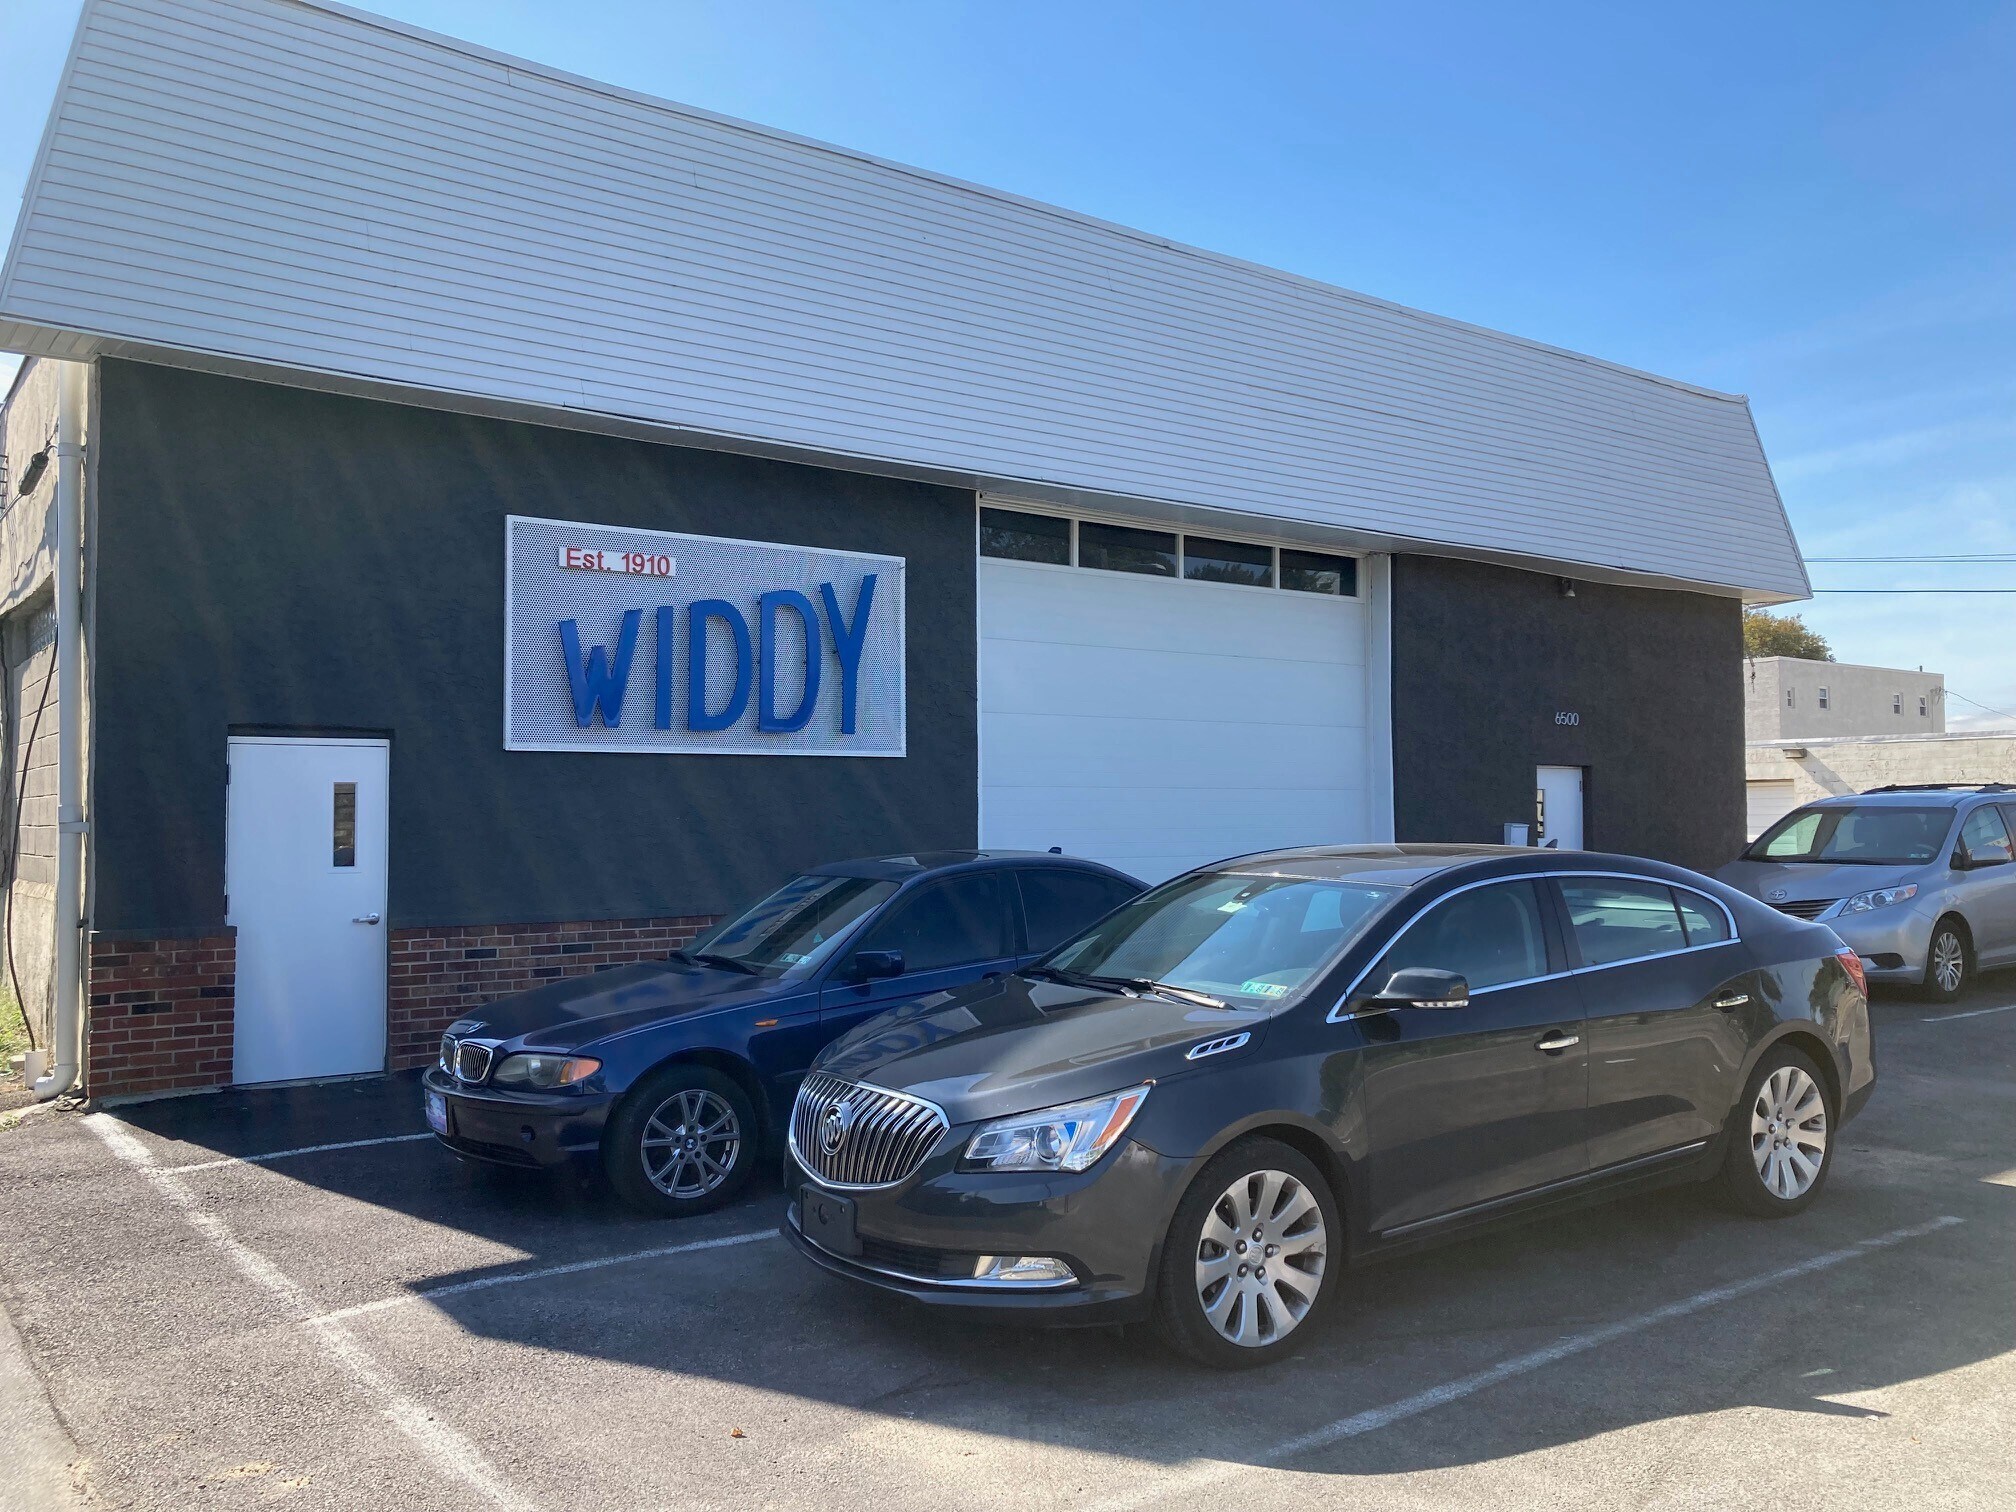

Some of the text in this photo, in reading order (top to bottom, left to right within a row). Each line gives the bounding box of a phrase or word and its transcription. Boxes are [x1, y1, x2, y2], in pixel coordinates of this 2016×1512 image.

[566, 547, 671, 576] Est. 1910
[559, 574, 878, 735] WIDDY
[1555, 712, 1579, 725] 6500
